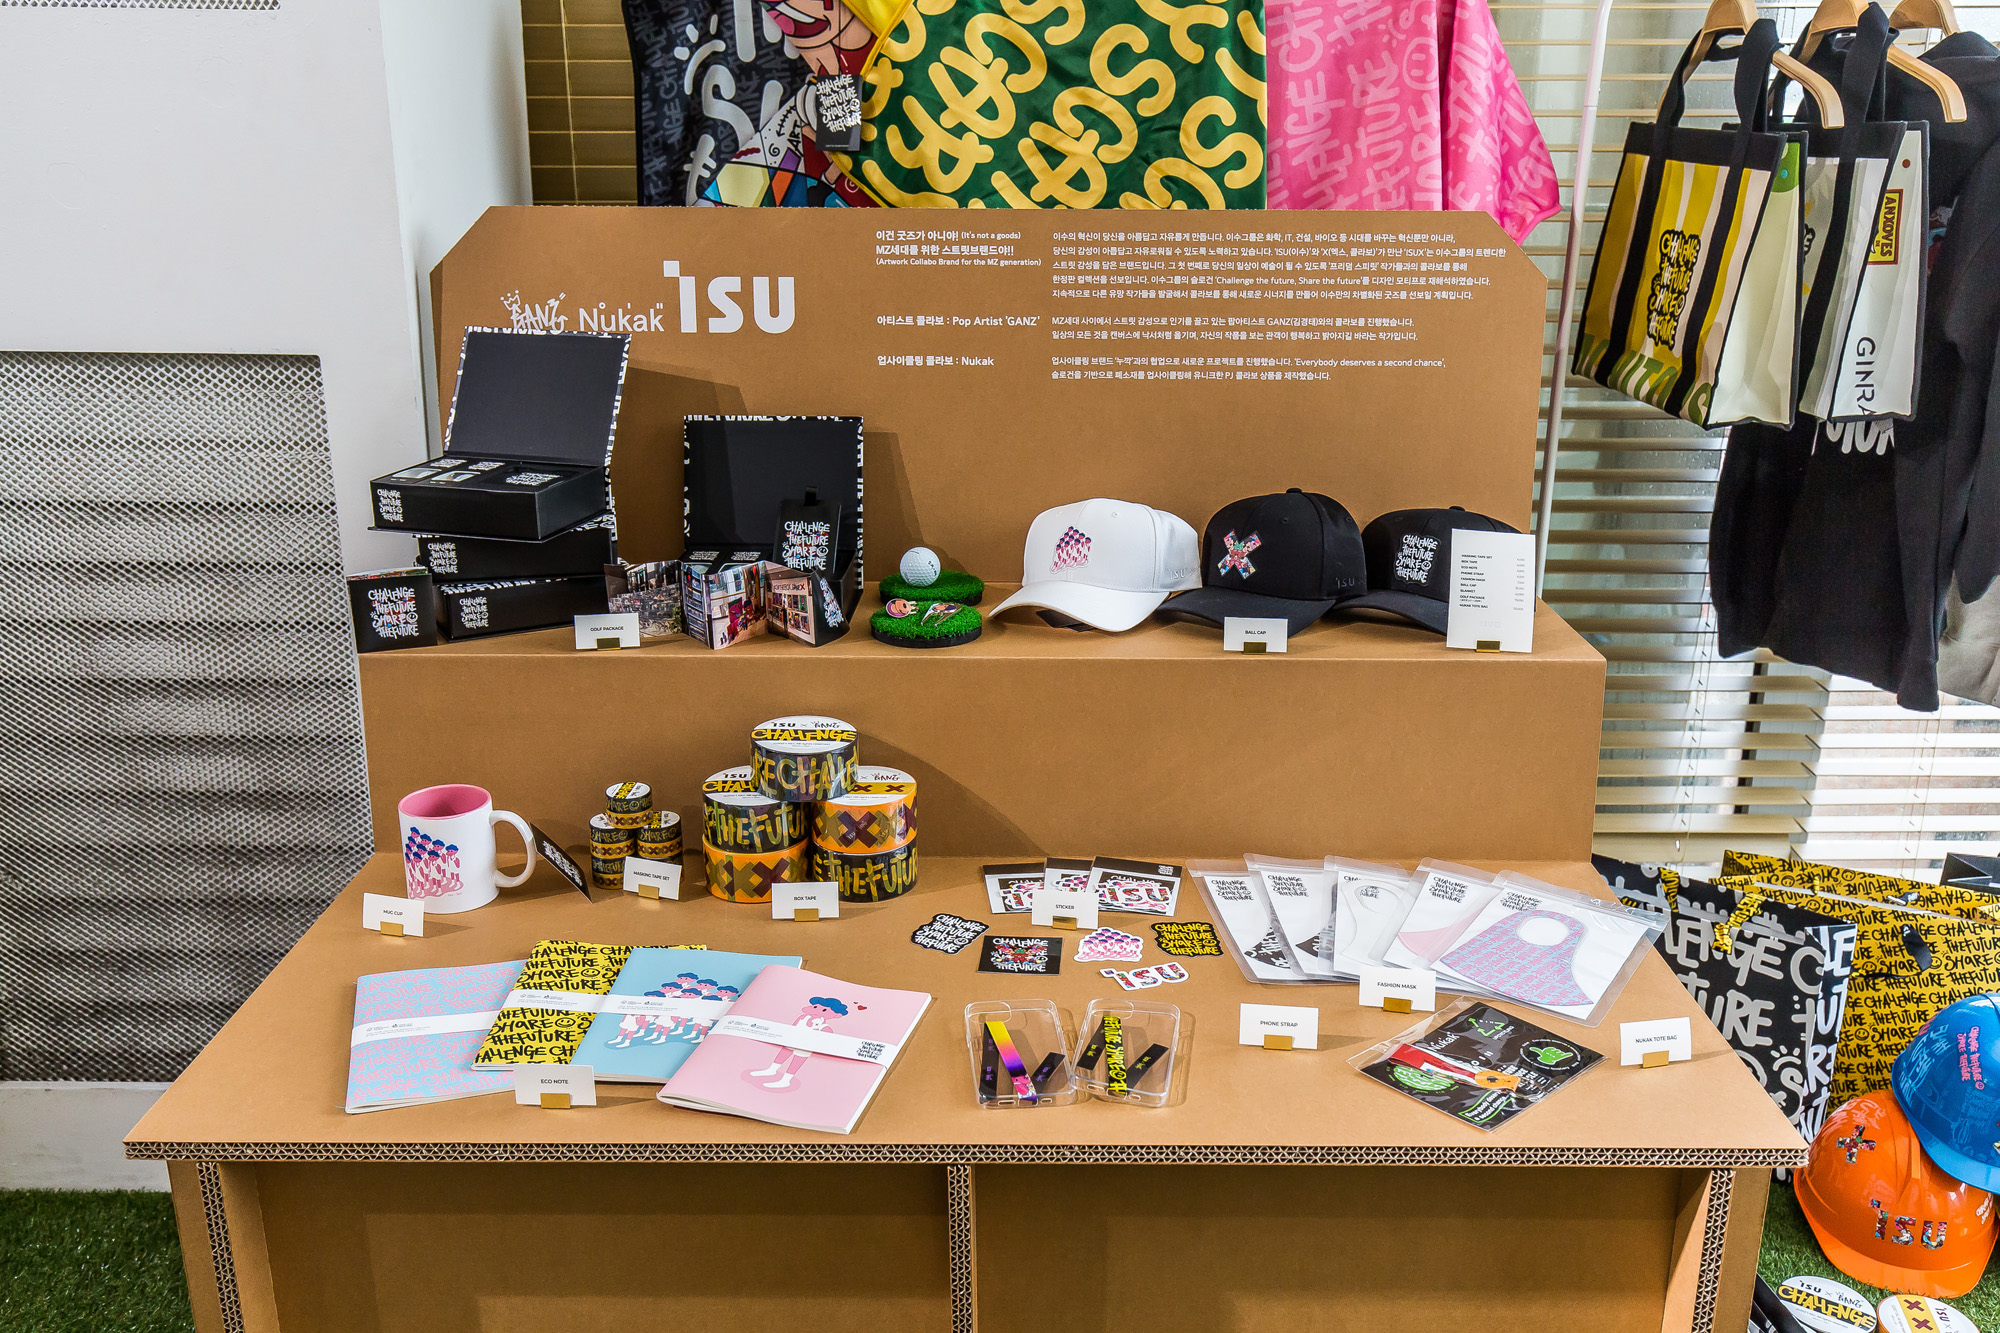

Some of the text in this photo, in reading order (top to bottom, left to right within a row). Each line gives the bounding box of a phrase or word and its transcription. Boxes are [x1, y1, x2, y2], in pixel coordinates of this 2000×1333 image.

[1880, 195, 1898, 258] ANXOVES
[876, 230, 895, 241] 이건
[896, 230, 926, 241] 굿즈가
[927, 230, 958, 241] 아니야!
[961, 231, 976, 239] (It's
[996, 231, 1021, 240] goods)
[1053, 232, 1456, 244] 이수의 혁신이 당신을 아름답고 자유롭게 만듭니다. 이수그룹은 화학, IT, 건설, 바이오 등 시대를 바꾸는 혁신뿐만 아니라,
[876, 244, 1014, 256] MZ세대를 위한 스트릿브랜드야!!
[876, 257, 908, 265] (Artwork
[1000, 258, 1042, 267] generation)
[1052, 274, 1076, 284] 한정판
[1077, 275, 1108, 284] 컬렉션을
[1109, 275, 1150, 284] 선보입니다.
[1150, 275, 1189, 284] 이수그룹의
[1190, 275, 1214, 284] 슬로건
[1256, 276, 1269, 284] the
[1270, 276, 1297, 286] future,
[1298, 276, 1321, 284] Share
[1322, 277, 1335, 285] the
[1372, 276, 1394, 286] 디자인
[1395, 276, 1427, 286] 모티프로
[1428, 276, 1491, 286] 재해석하였습니다.
[663, 260, 796, 334] ISU
[876, 315, 914, 326] 아티스트
[916, 315, 944, 326] 콜라보
[952, 316, 971, 328] Pop
[973, 316, 1003, 326] Artist
[1005, 315, 1040, 326] 'GANZ'
[877, 355, 923, 366] 업사이클링
[925, 355, 954, 366] 콜라보
[961, 356, 994, 366] Nukak
[1051, 356, 1089, 366] 업사이클링
[1090, 356, 1114, 366] 브랜드
[1150, 356, 1180, 366] 협업으로
[1181, 357, 1205, 366] 새로운
[1206, 357, 1244, 366] 프로젝트를
[1245, 357, 1293, 366] 진행했습니다.
[1340, 358, 1376, 366] deserves
[1384, 358, 1413, 366] second
[1154, 923, 1211, 932] CHALLENGE
[1162, 940, 1202, 948] SHARE
[1427, 1032, 1460, 1052] Nukak
[1869, 1198, 1948, 1250] ISU
